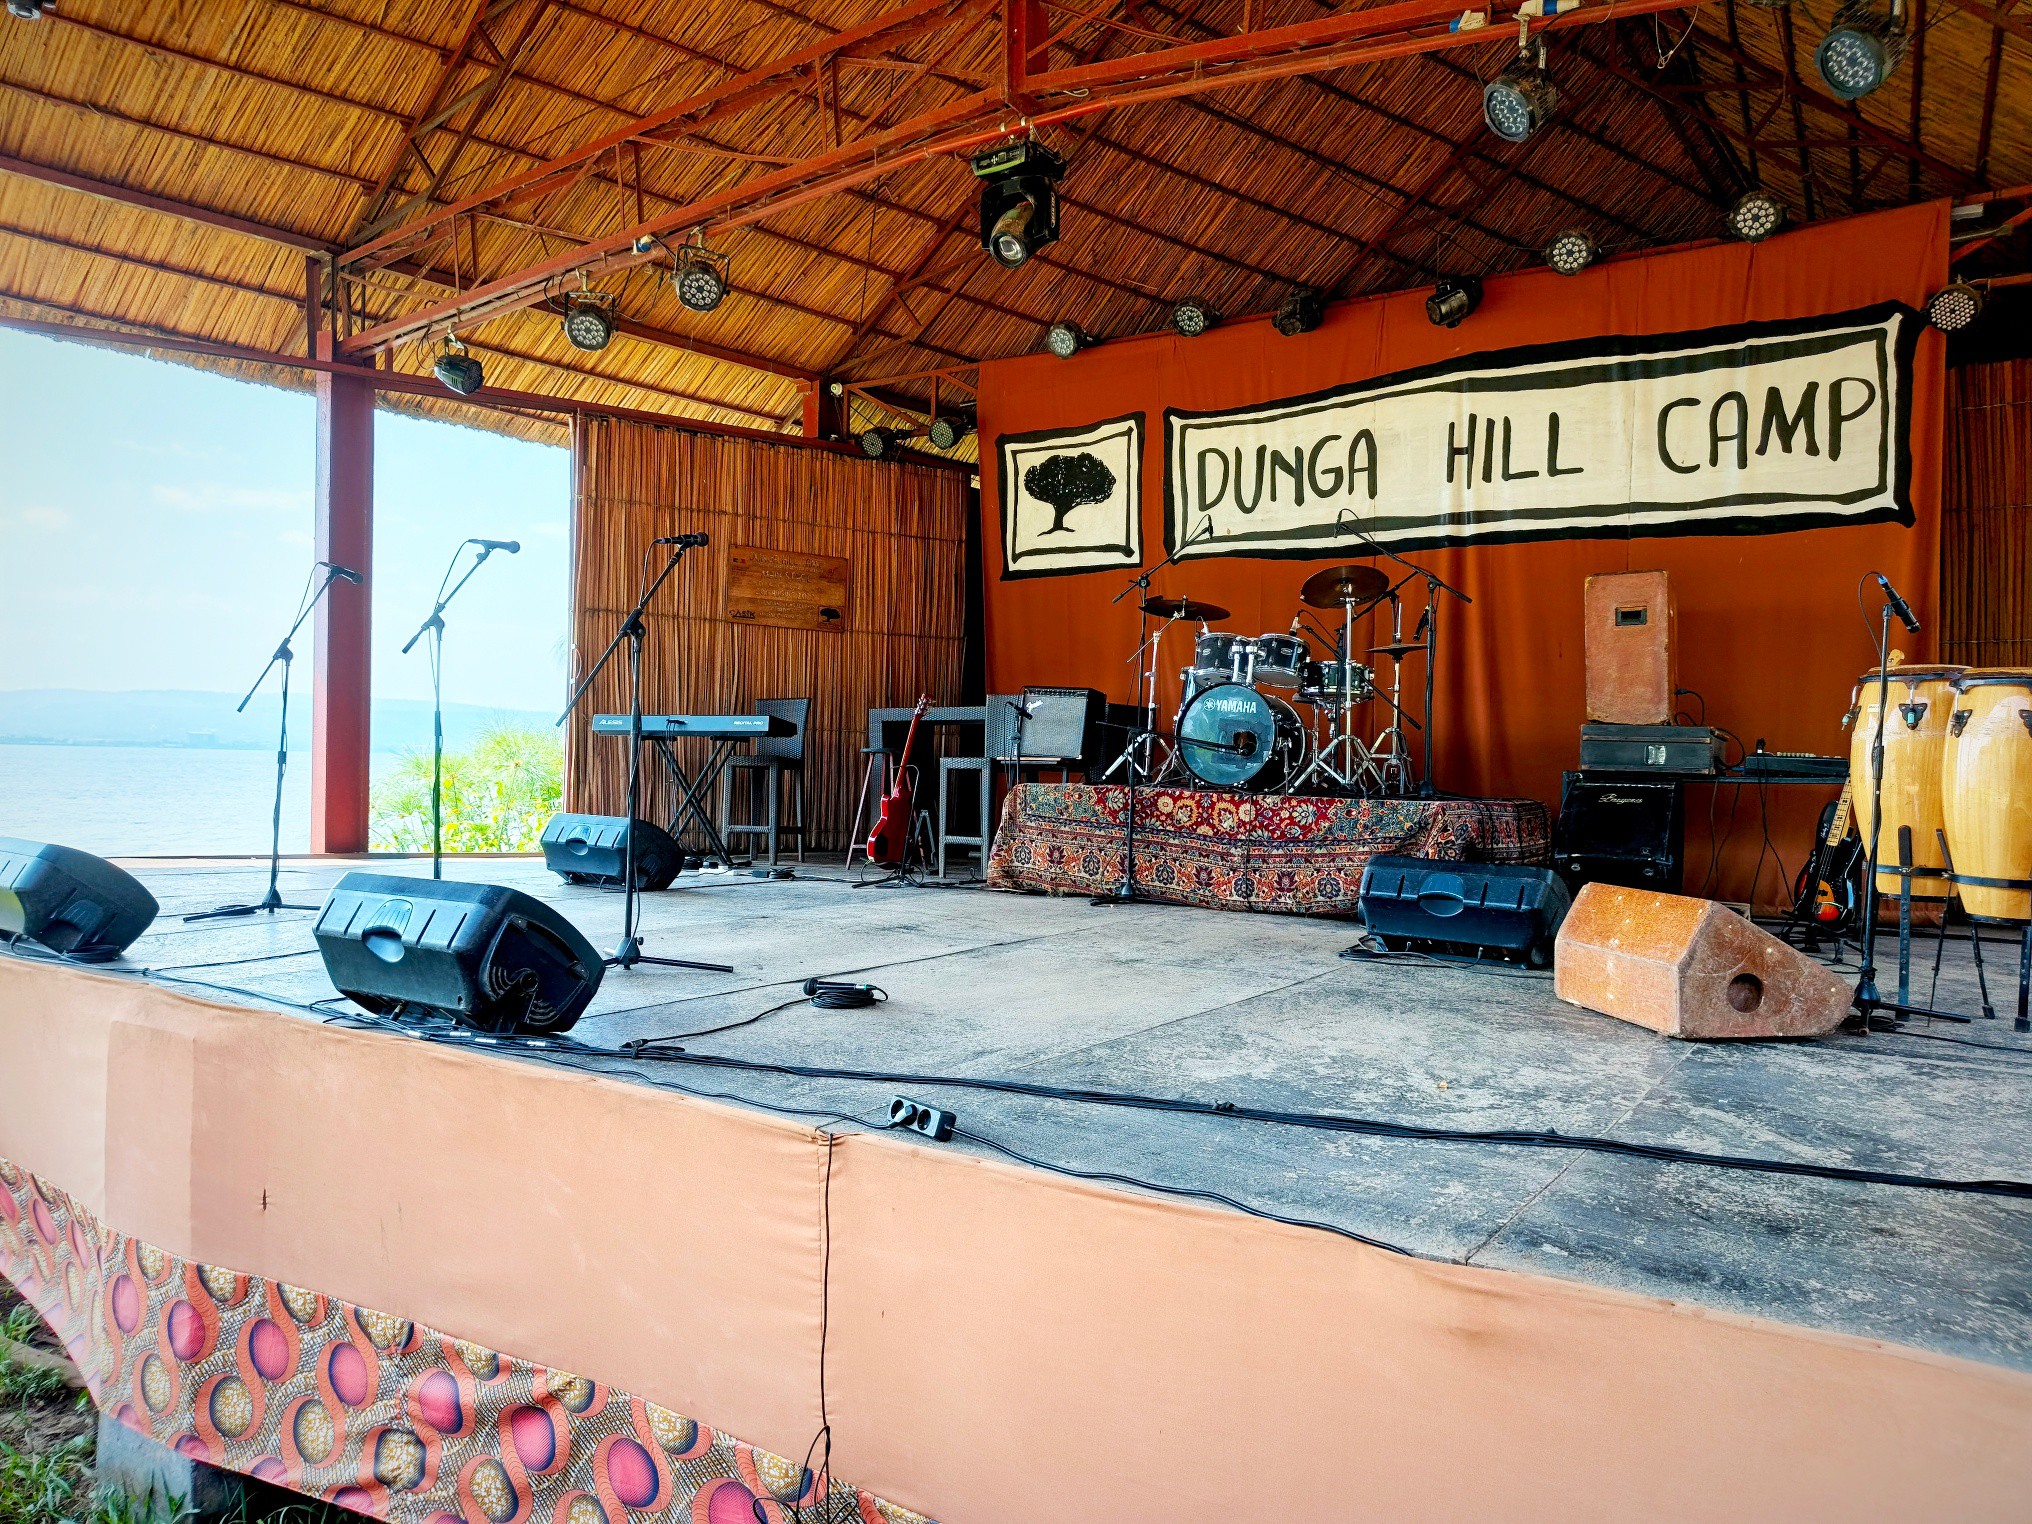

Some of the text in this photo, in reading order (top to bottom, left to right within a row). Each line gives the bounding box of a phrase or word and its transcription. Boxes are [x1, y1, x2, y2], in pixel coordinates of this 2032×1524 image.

[1197, 376, 1877, 515] DUNGA HILL CAMP
[1216, 699, 1257, 714] YAMAHA
